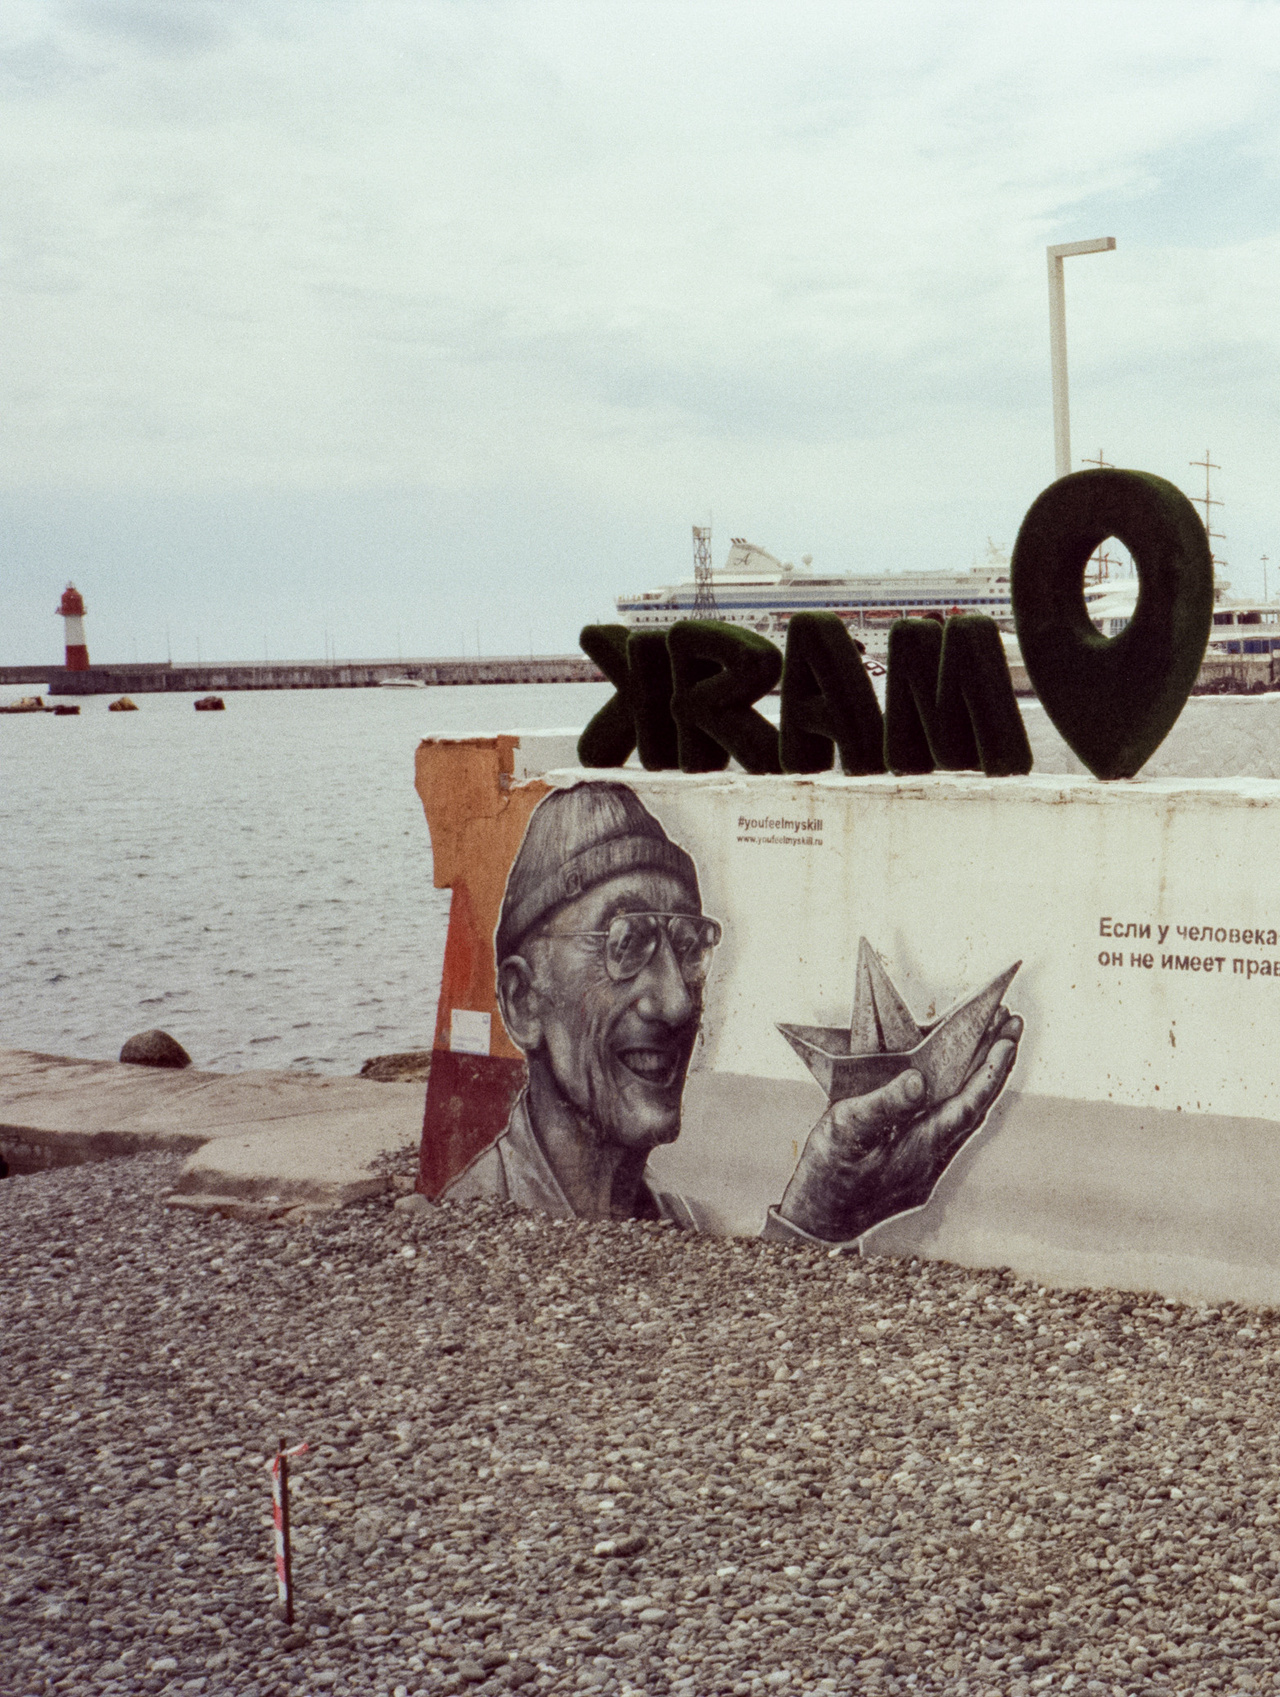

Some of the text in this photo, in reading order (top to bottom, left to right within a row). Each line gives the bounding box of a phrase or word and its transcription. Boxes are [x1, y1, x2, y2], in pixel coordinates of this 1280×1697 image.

[737, 815, 824, 833] #youfeelmyskill
[736, 834, 824, 847] www.youfeelmyskill.ru
[1099, 916, 1152, 940] Если
[1157, 924, 1170, 946] у
[1176, 925, 1279, 946] человека
[1097, 950, 1124, 967] он
[1129, 952, 1155, 970] не
[1160, 953, 1227, 973] имеет
